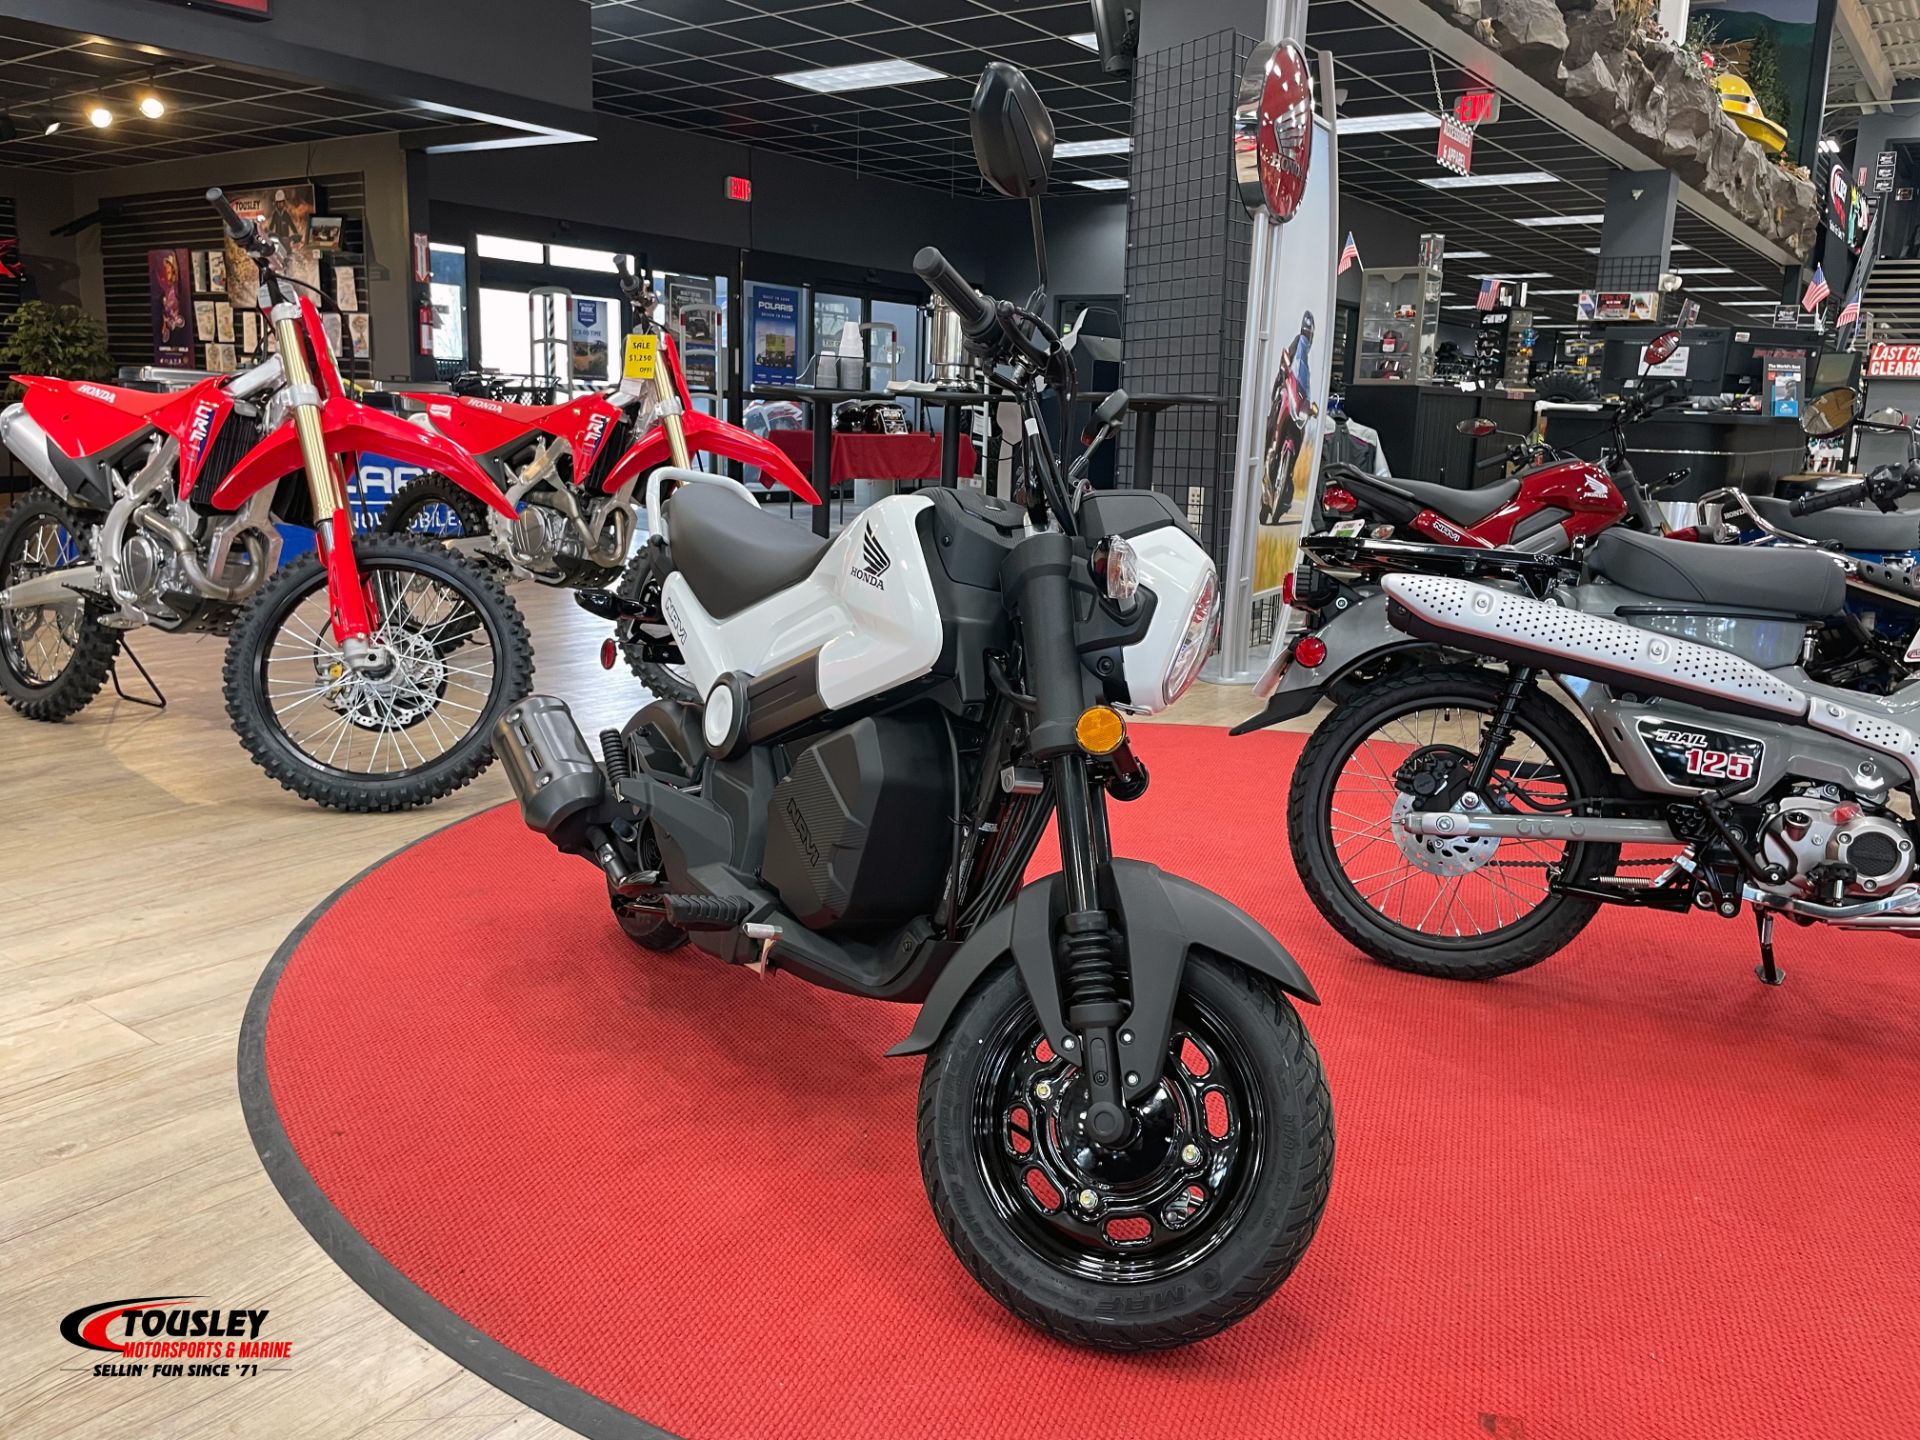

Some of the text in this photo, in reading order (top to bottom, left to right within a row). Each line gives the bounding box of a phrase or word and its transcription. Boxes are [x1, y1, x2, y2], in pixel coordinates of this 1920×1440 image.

[1461, 93, 1494, 122] EXIT
[731, 177, 751, 200] EXIT
[759, 301, 793, 312] POLARIS
[1872, 346, 1906, 361] LAST
[76, 383, 117, 405] HONDA
[467, 398, 503, 414] HONDA
[1723, 508, 1746, 520] HOND
[1432, 520, 1461, 543] NAVI
[850, 565, 885, 591] HONDA
[664, 596, 688, 646] NAVI
[1652, 728, 1708, 748] TRAIL
[1685, 748, 1754, 780] 125
